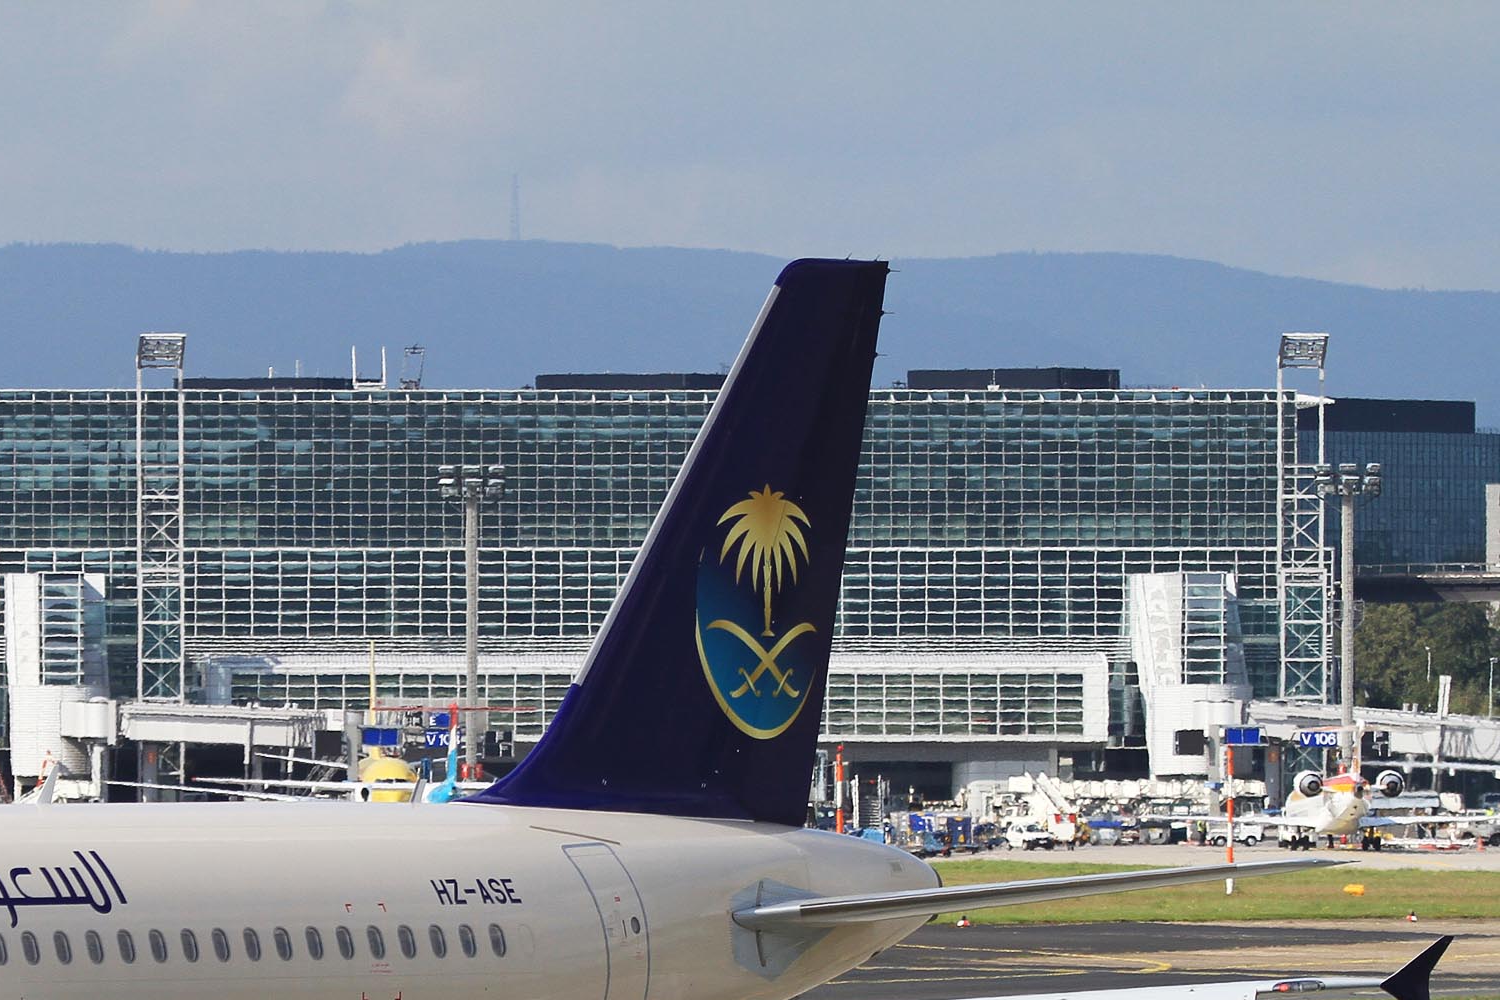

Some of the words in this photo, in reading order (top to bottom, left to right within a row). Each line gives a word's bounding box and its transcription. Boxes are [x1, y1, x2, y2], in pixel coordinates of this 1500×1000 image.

[426, 734, 436, 746] V
[1301, 733, 1311, 745] V
[1314, 733, 1336, 746] 106
[430, 878, 522, 905] HZ-ASE
